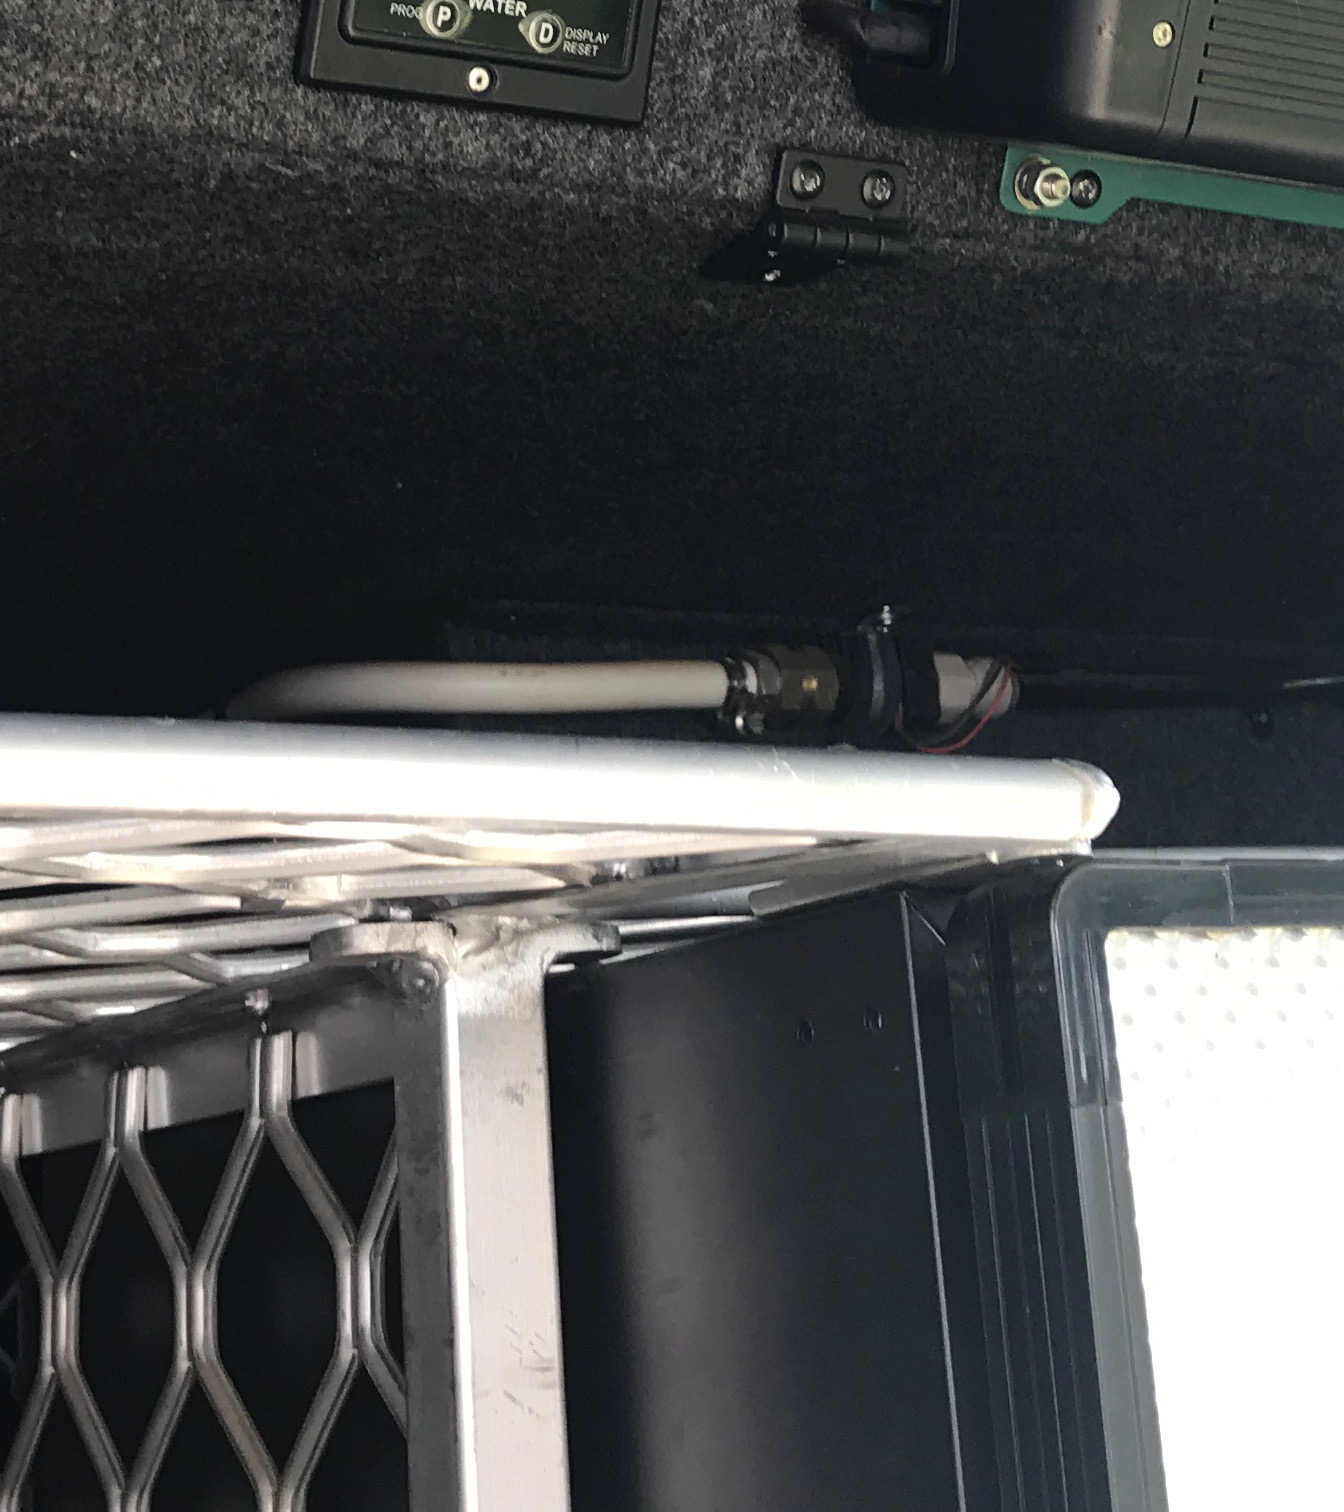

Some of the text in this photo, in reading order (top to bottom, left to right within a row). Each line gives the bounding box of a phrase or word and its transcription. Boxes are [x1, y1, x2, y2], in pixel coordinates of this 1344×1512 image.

[436, 4, 452, 28] P
[538, 21, 554, 44] D
[564, 25, 609, 46] DISPLAY
[562, 39, 600, 58] RESET
